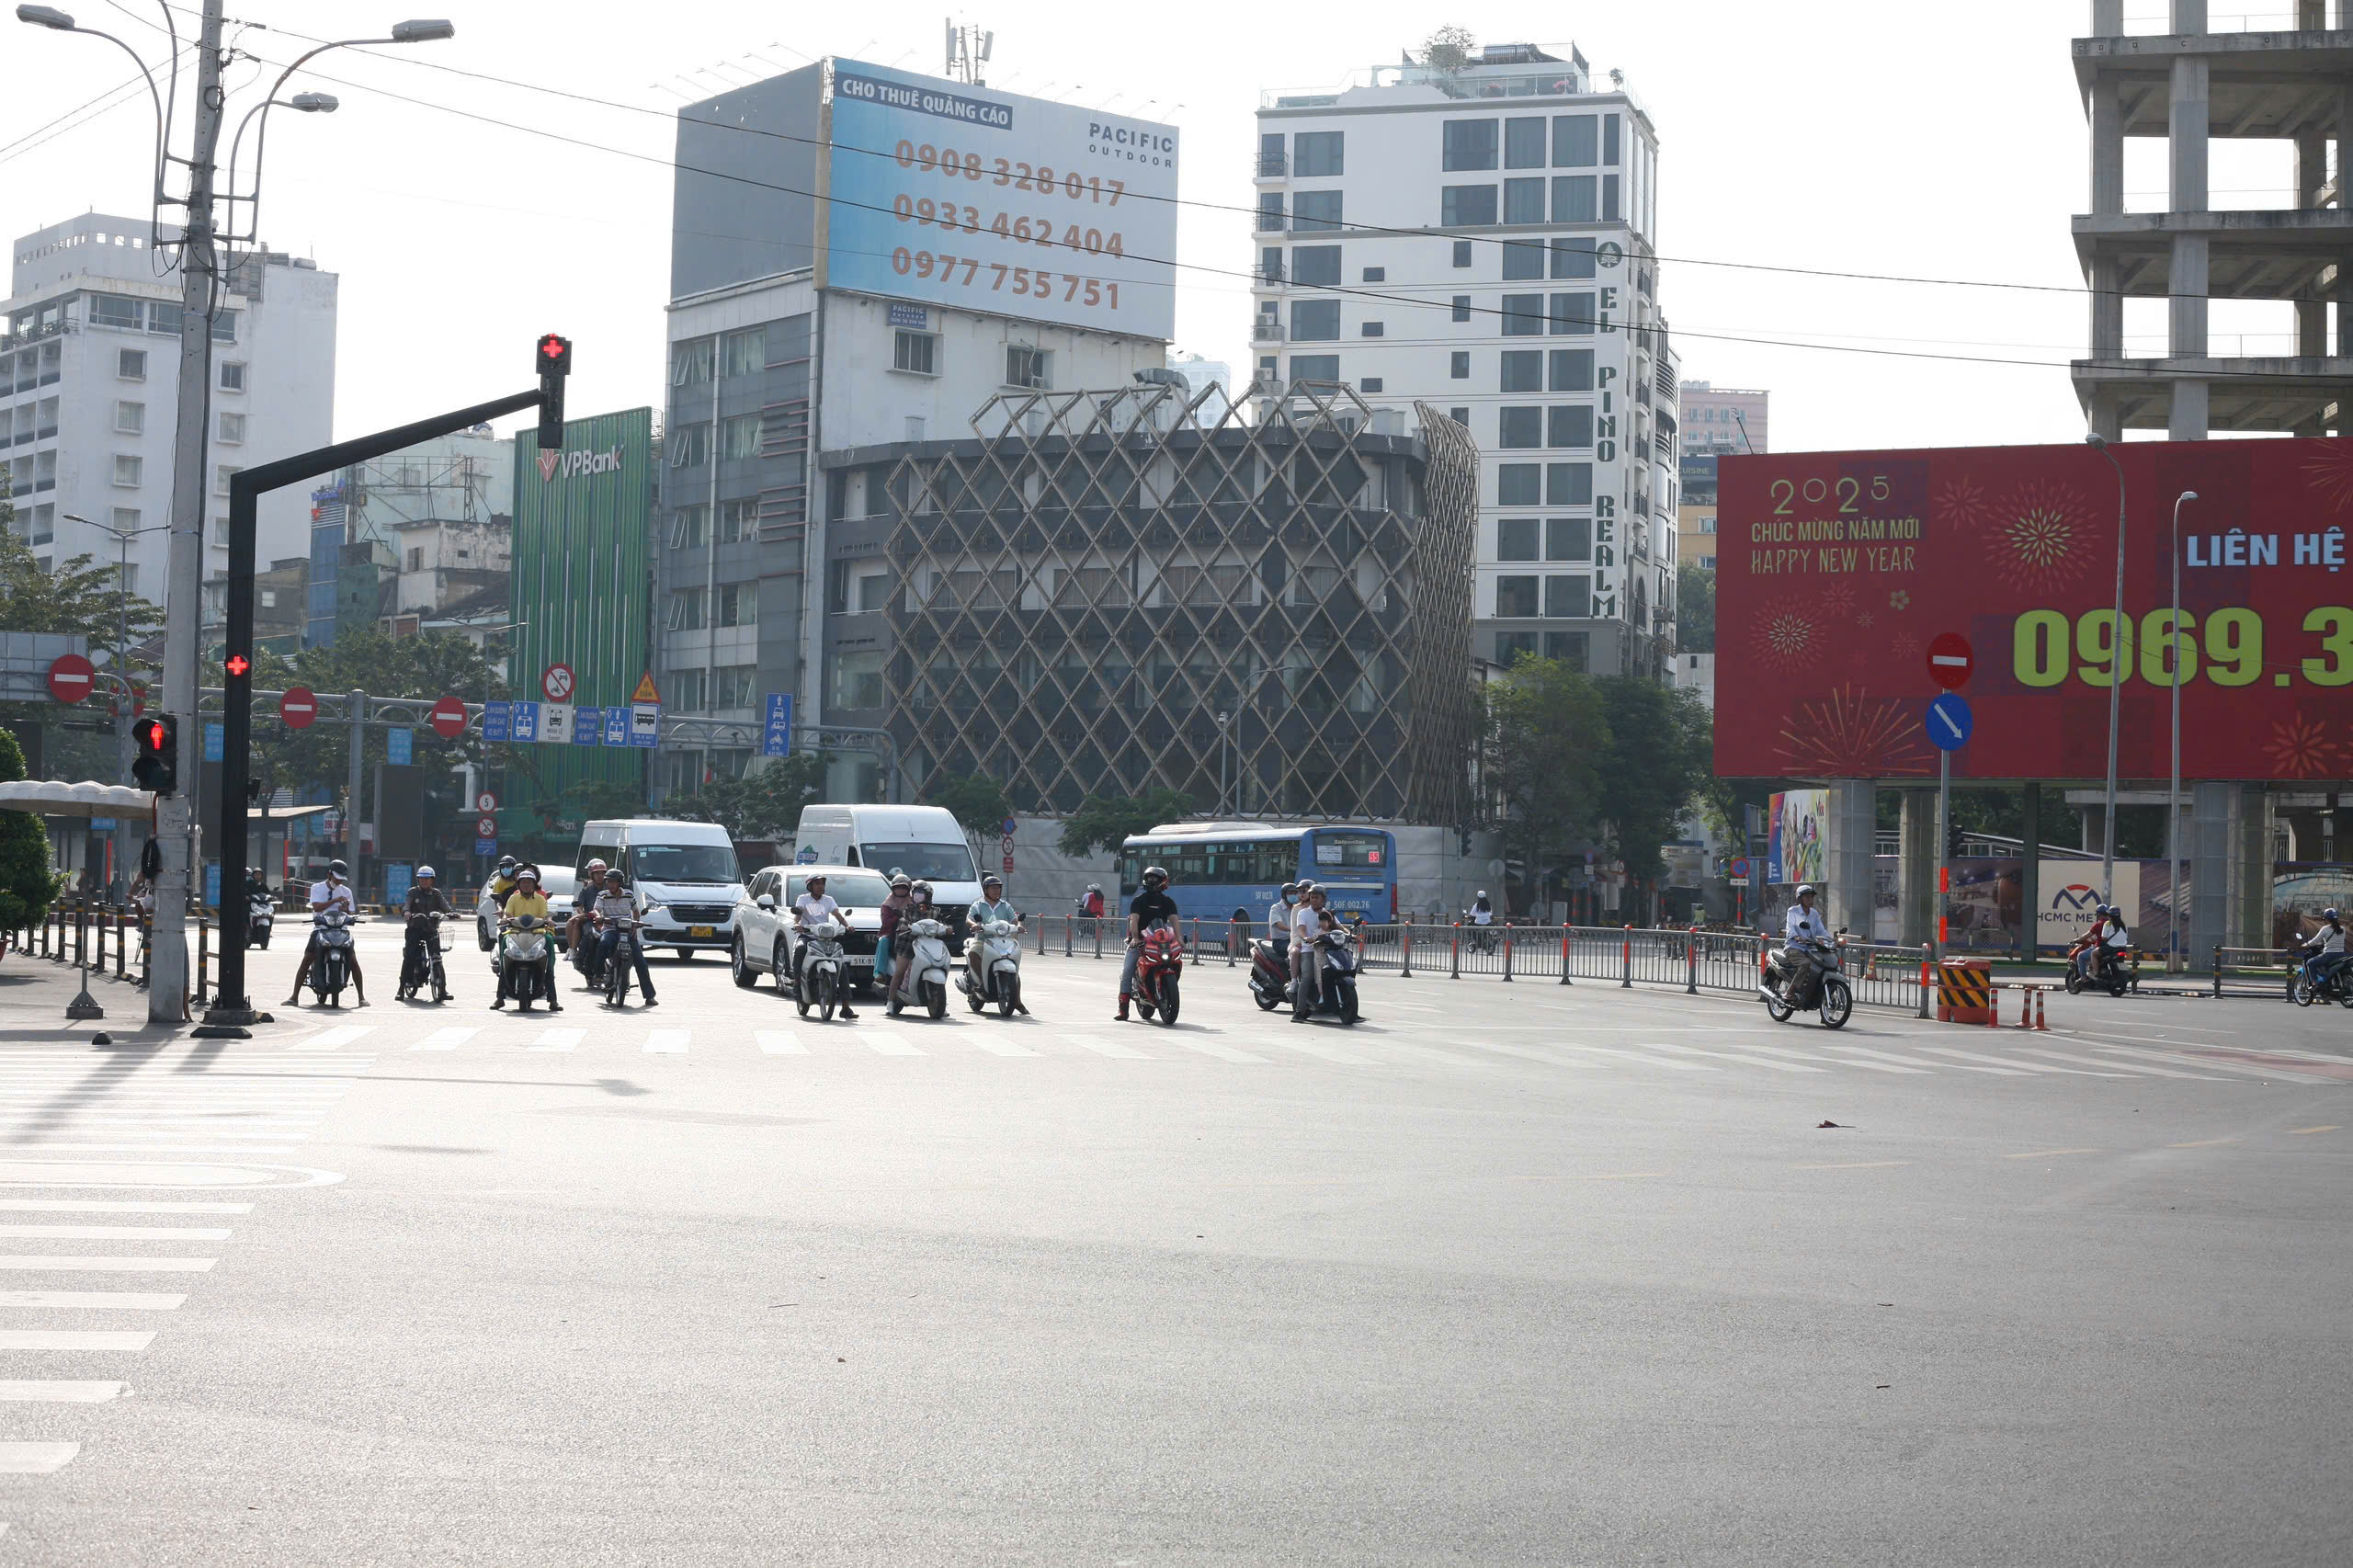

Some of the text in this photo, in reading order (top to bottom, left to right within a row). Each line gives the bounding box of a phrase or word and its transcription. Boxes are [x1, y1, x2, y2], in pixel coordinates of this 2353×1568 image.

[842, 79, 1009, 125] CHO THUÊ QUẢNG CÁO
[1089, 122, 1173, 153] PACIFIC
[895, 140, 1125, 207] 0908 328 017
[1089, 144, 1172, 168] OUTDOOR
[893, 194, 1123, 259] 0933 462 404
[892, 246, 1119, 310] 0977 755 751
[892, 305, 925, 313] PACIFIC
[1600, 287, 1618, 333] EL
[1597, 367, 1617, 461] PINO
[561, 444, 625, 479] VPBank
[1770, 475, 1890, 515] 2025
[1751, 515, 1920, 543] CHÚC MỪNG NĂM MỚI
[1592, 495, 1616, 617] REALM
[1751, 546, 1915, 574] HAPPY NEW YEAR
[2187, 526, 2346, 573] LIÊN HỆ
[484, 798, 489, 808] 5
[1370, 852, 1379, 862] 55
[1334, 901, 1370, 909] 50F 002.76
[2037, 913, 2072, 923] HCMC
